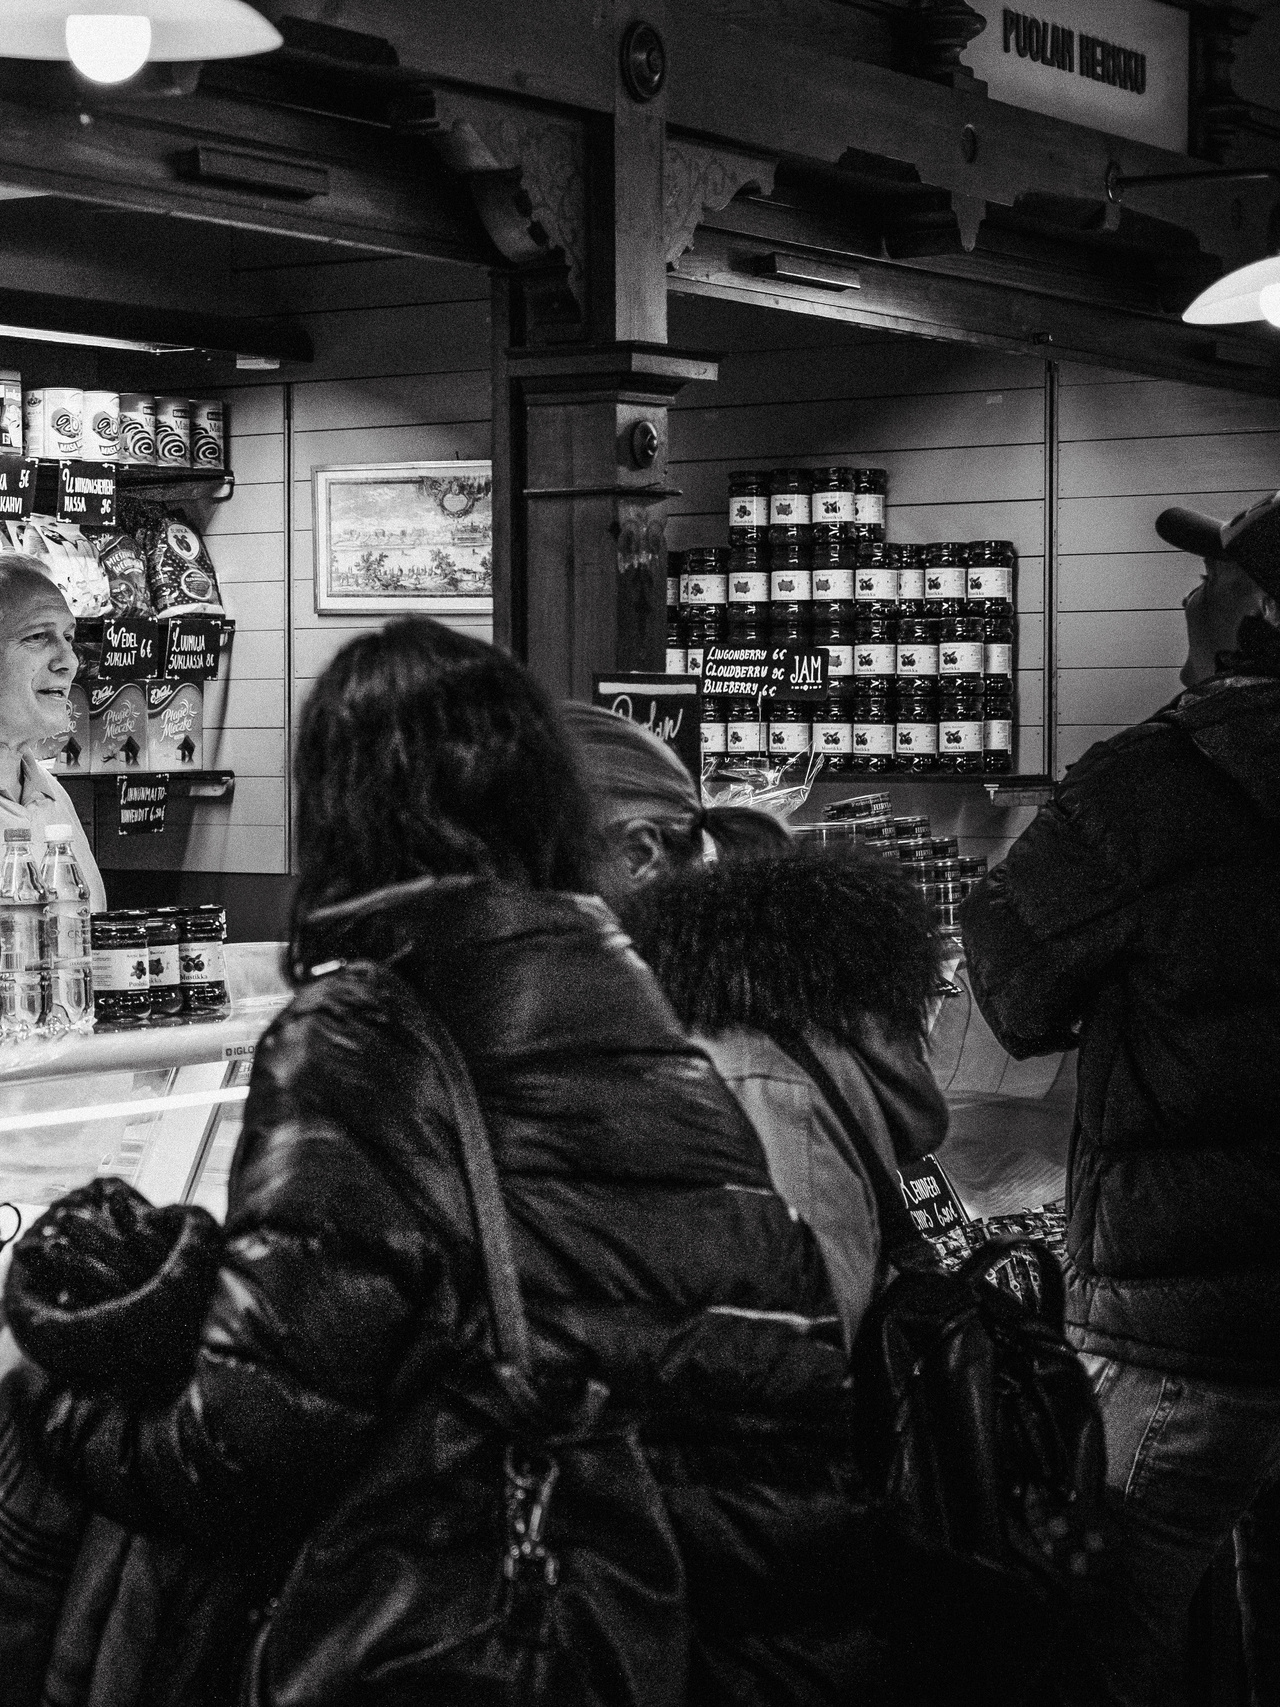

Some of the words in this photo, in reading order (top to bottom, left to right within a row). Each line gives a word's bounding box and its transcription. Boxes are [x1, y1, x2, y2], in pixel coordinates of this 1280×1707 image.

[1003, 8, 1074, 72] PUOLAN
[19, 469, 31, 489] 5€
[64, 496, 87, 513] MASSA
[100, 498, 112, 514] 9€
[106, 625, 139, 648] WEDEL
[171, 626, 206, 653] LUUMUJA
[104, 650, 138, 667] SUKLAAT
[140, 638, 153, 658] 6€
[167, 653, 204, 670] SUKLAASSA
[205, 653, 215, 668] 8€
[706, 646, 768, 661] LINGONBERRY
[705, 661, 769, 679] CLOUDBERRY
[789, 655, 823, 684] JAM
[703, 678, 759, 696] BLUEBERRY
[179, 973, 209, 982] Mustikka
[909, 1208, 934, 1231] CHIPS
